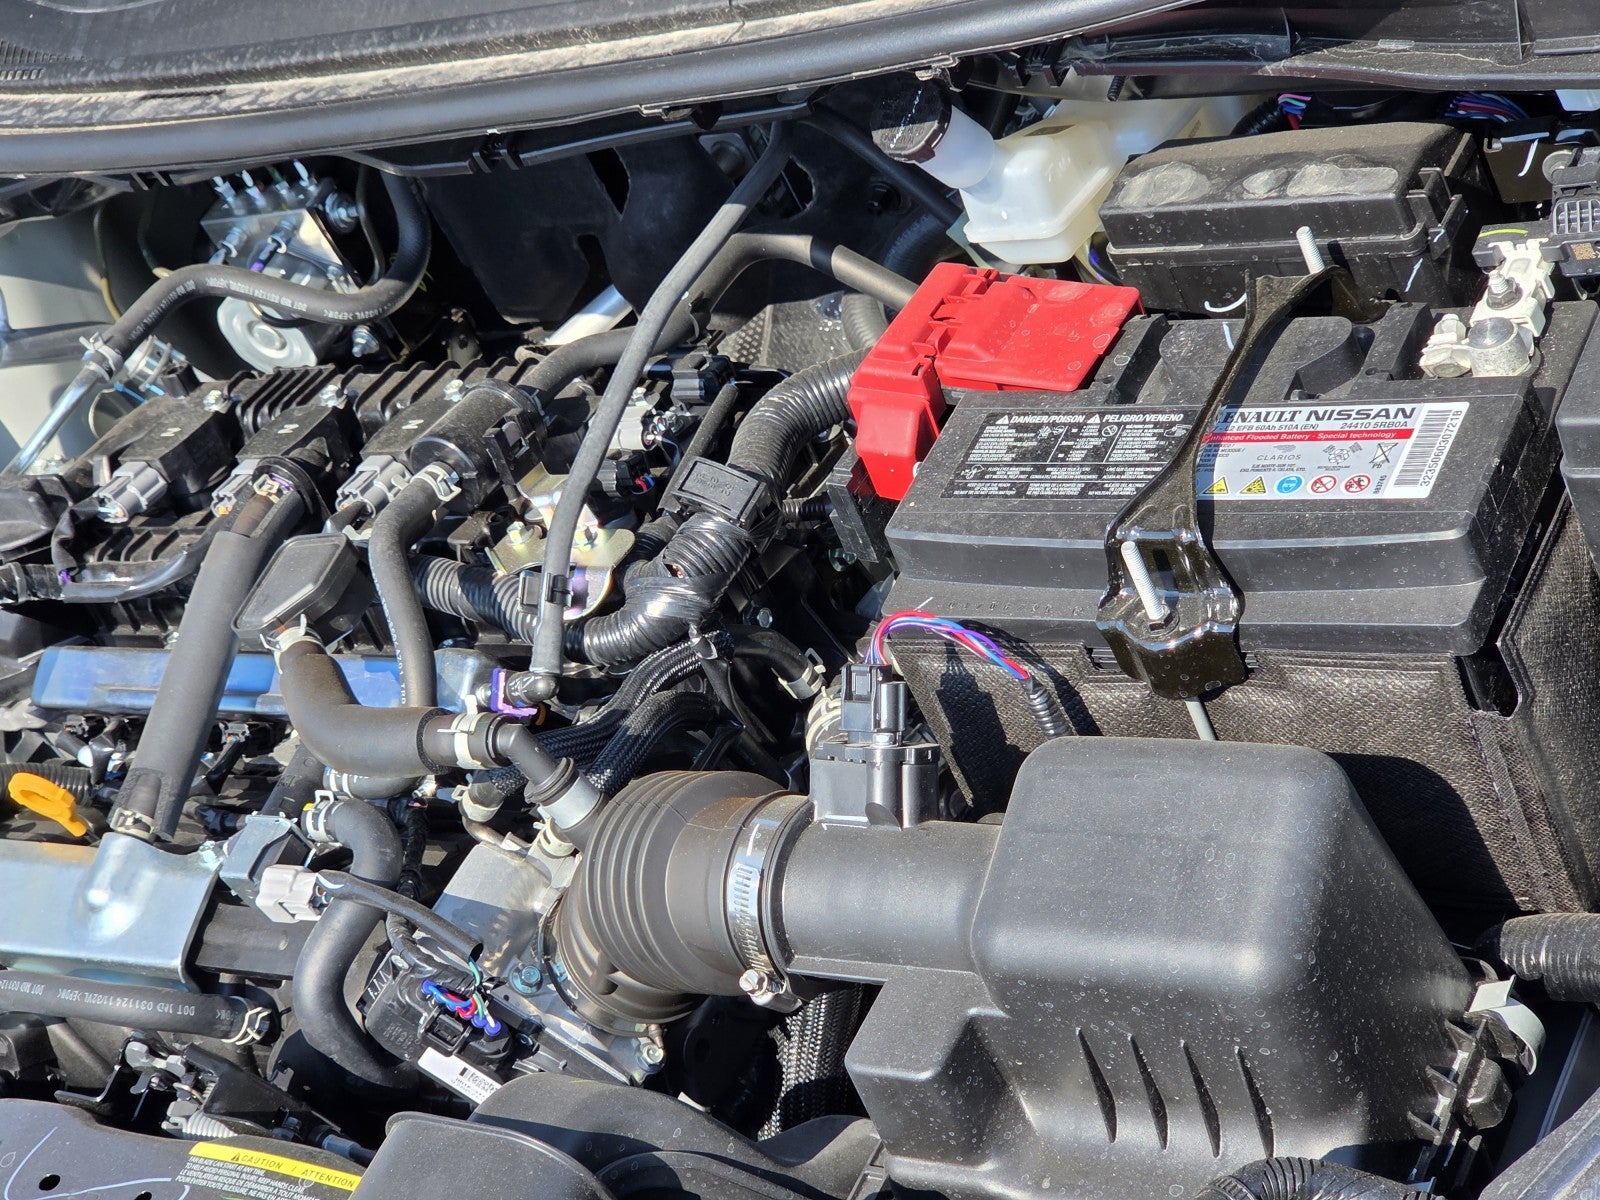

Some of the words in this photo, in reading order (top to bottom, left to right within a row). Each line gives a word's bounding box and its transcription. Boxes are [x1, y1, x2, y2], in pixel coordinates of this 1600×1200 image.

[1010, 415, 1086, 424] DANGER/POISON
[1102, 414, 1184, 423] PELIGRO/VENENO
[1217, 410, 1302, 424] ENAULT
[1305, 407, 1416, 422] NISSAN
[1300, 423, 1319, 431] (EN)
[1340, 422, 1371, 430] 24410
[1246, 433, 1279, 441] Flooded
[1280, 433, 1310, 441] Battery
[1318, 432, 1348, 440] Special
[1349, 431, 1397, 439] technology
[110, 998, 153, 1012] 031124
[176, 1004, 195, 1016] DOT
[242, 1154, 284, 1170] CAUTION
[300, 1169, 356, 1189] ATTENTION
[175, 1175, 192, 1183] POUR
[269, 1180, 289, 1190] HANDS
[278, 1189, 295, 1198] TOUT
